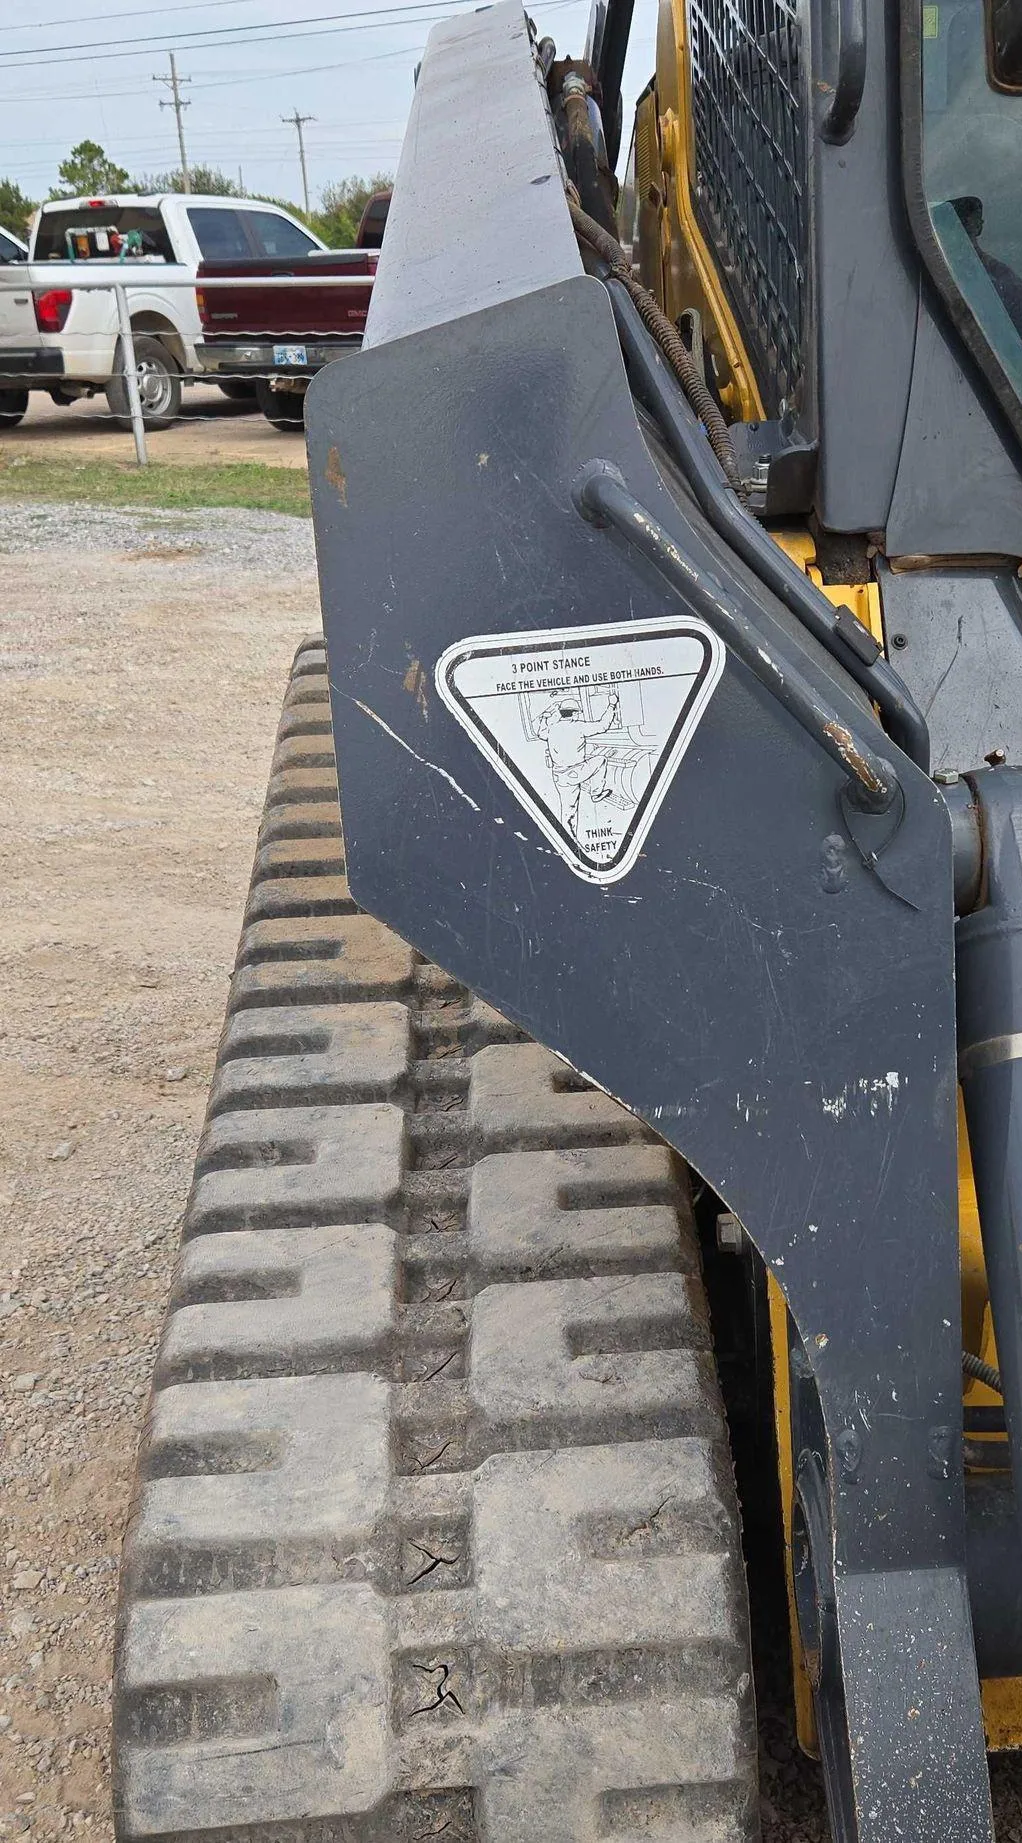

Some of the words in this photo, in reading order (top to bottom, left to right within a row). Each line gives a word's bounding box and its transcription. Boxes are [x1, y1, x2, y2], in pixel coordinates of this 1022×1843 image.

[512, 664, 517, 674] 3
[520, 661, 549, 673] POINT
[553, 656, 591, 670] STANCE
[496, 682, 516, 692] FACE
[518, 680, 534, 690] THE
[536, 676, 571, 688] VEHICLE
[573, 675, 590, 684] AND
[592, 672, 608, 682] USE
[610, 670, 632, 680] BOTH
[635, 666, 664, 677] HANDS.
[585, 827, 613, 838] THINK
[585, 840, 617, 853] SAFETY
